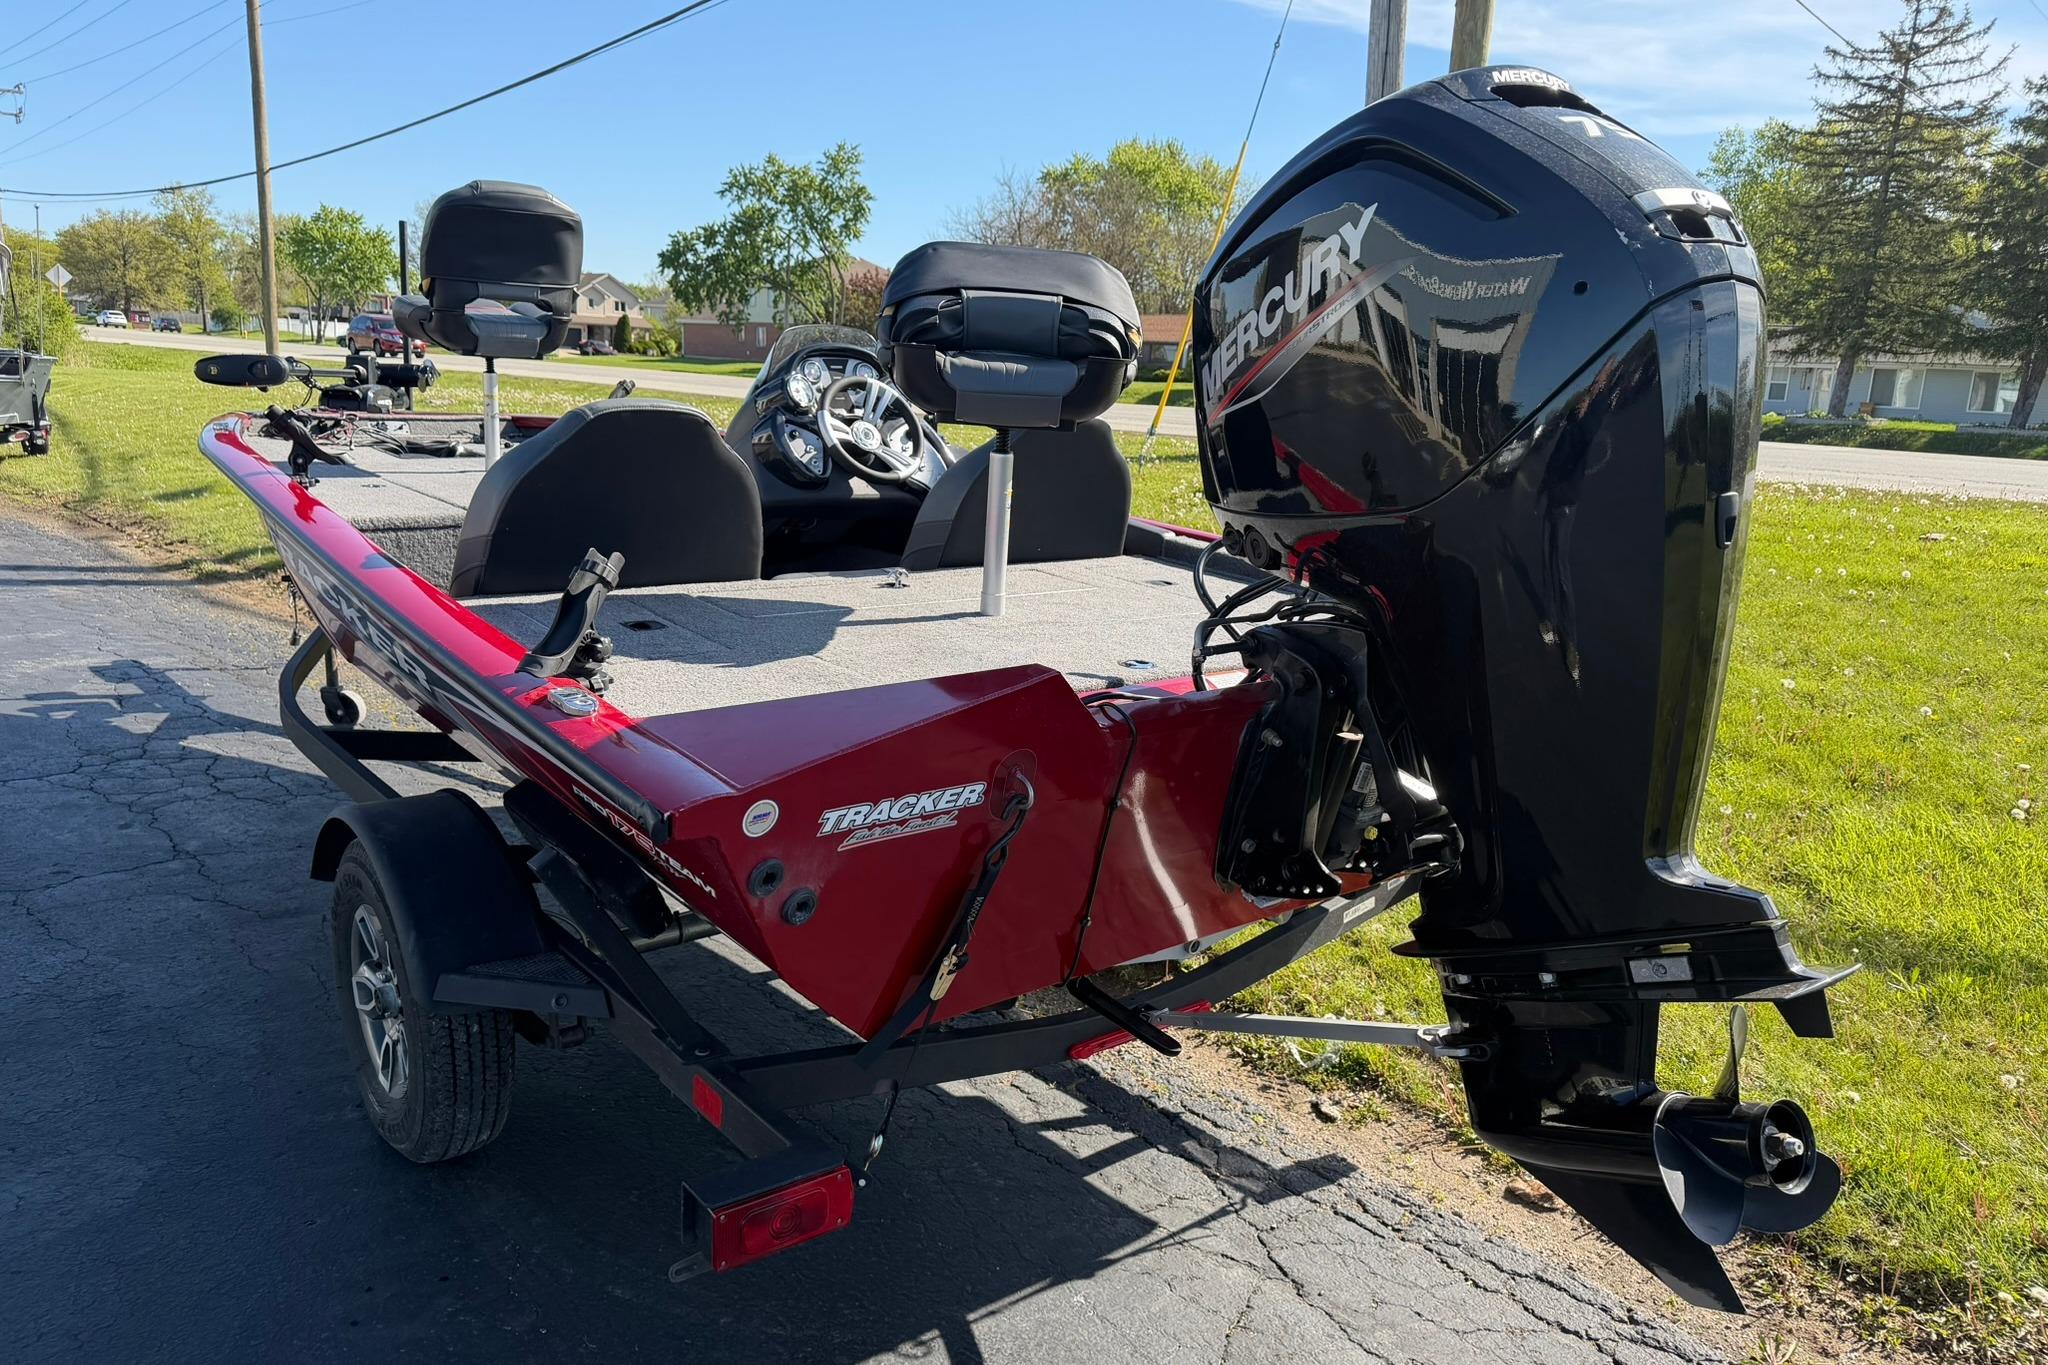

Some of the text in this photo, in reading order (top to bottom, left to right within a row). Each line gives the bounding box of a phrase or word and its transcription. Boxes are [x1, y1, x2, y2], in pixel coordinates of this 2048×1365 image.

[1492, 71, 1570, 91] MERCURY
[1201, 202, 1378, 406] MERCURY
[818, 782, 986, 836] TRACKER
[655, 846, 717, 900] TEAM
